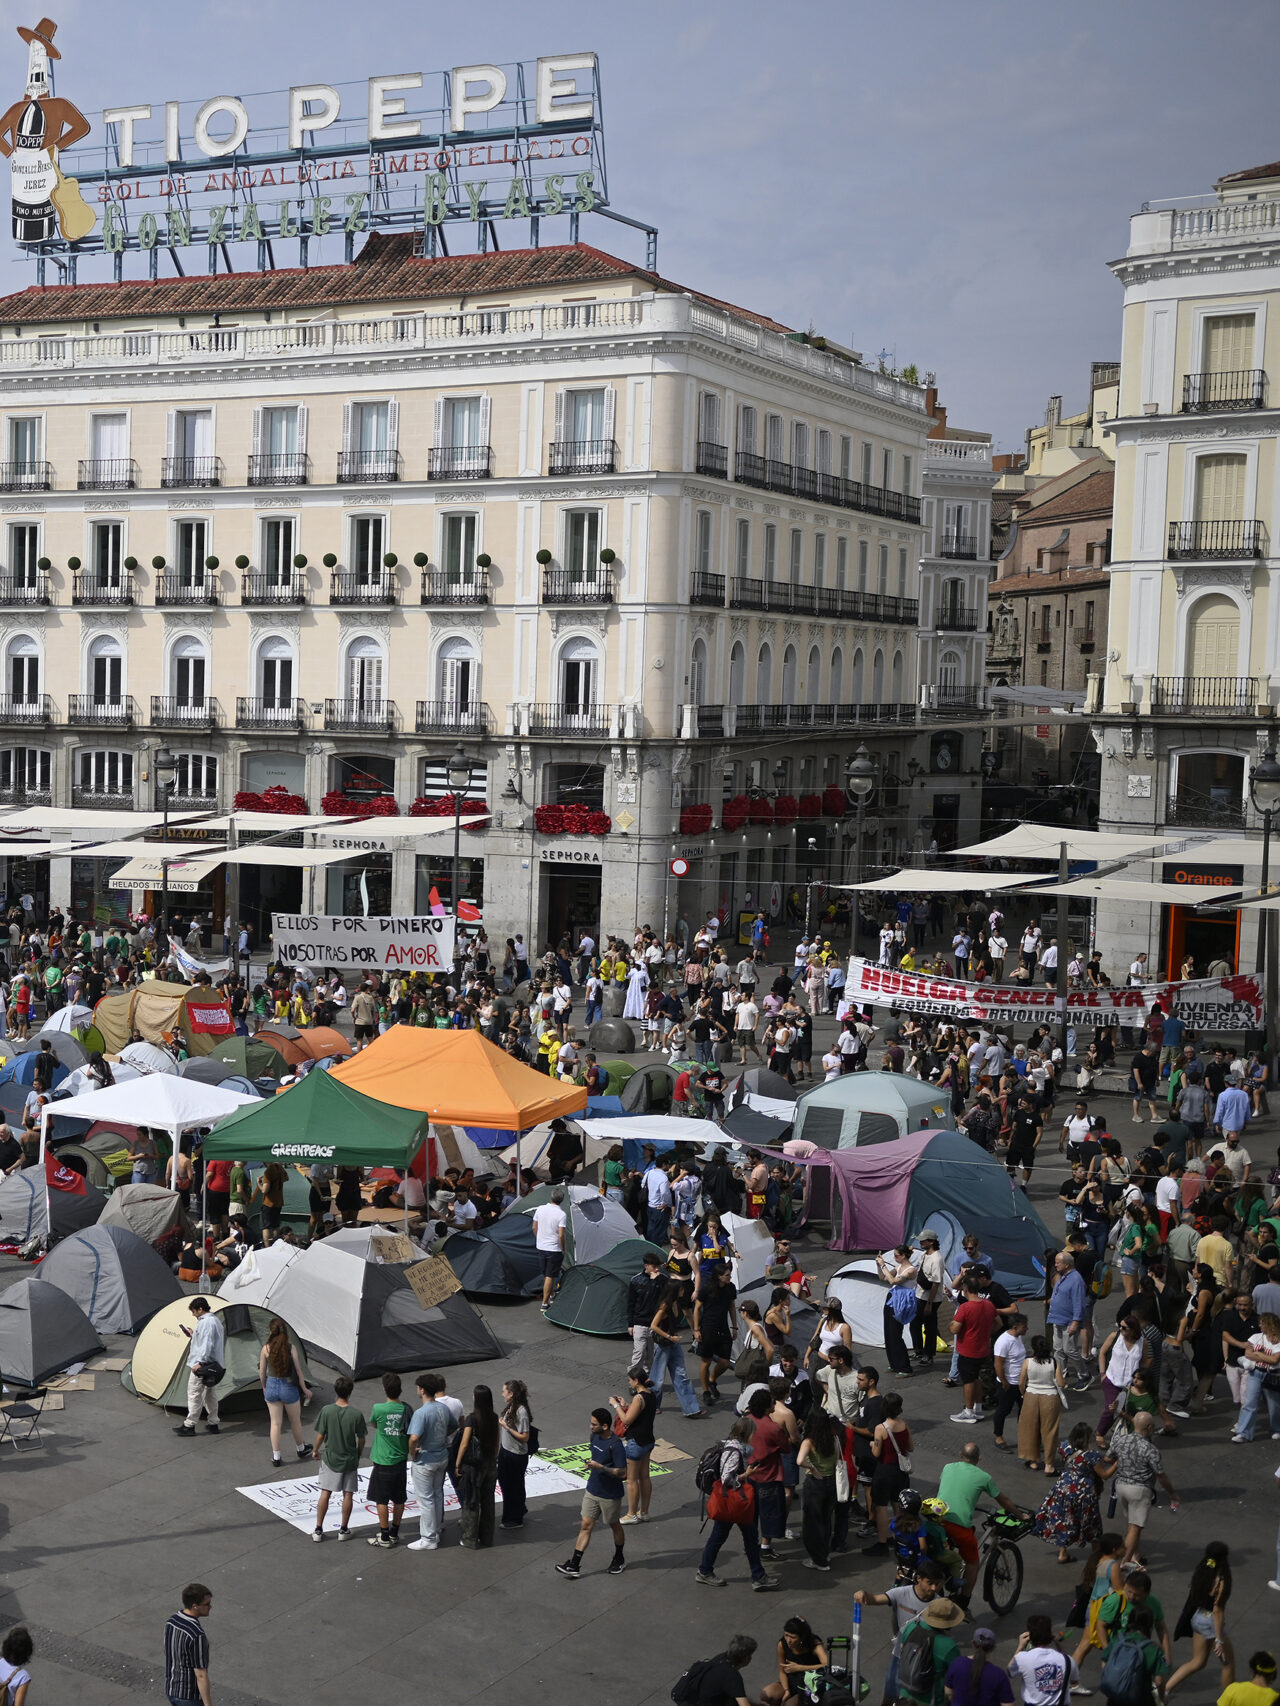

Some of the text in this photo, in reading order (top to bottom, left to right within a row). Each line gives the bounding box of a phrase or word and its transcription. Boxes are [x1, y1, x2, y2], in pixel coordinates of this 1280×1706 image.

[102, 52, 596, 168] TIO PEPE
[97, 136, 591, 202] SOL DE ANDALUCIA EMBOTELLADO
[23, 178, 47, 190] JEREZ
[102, 171, 596, 252] GONZALEZ BYASS
[332, 839, 387, 851] SEPHORA
[542, 850, 600, 862] SEPHORA
[112, 881, 150, 889] HELADOS
[1175, 870, 1233, 886] Orange
[277, 915, 444, 935] ELLOS POR DINERO
[278, 943, 440, 966] NOSOTRAS POR AMOR
[860, 967, 968, 1002] HUELGA
[1108, 991, 1146, 1008] YA
[891, 998, 970, 1017] IZQUIERDA
[270, 1143, 336, 1158] GREENPEACE
